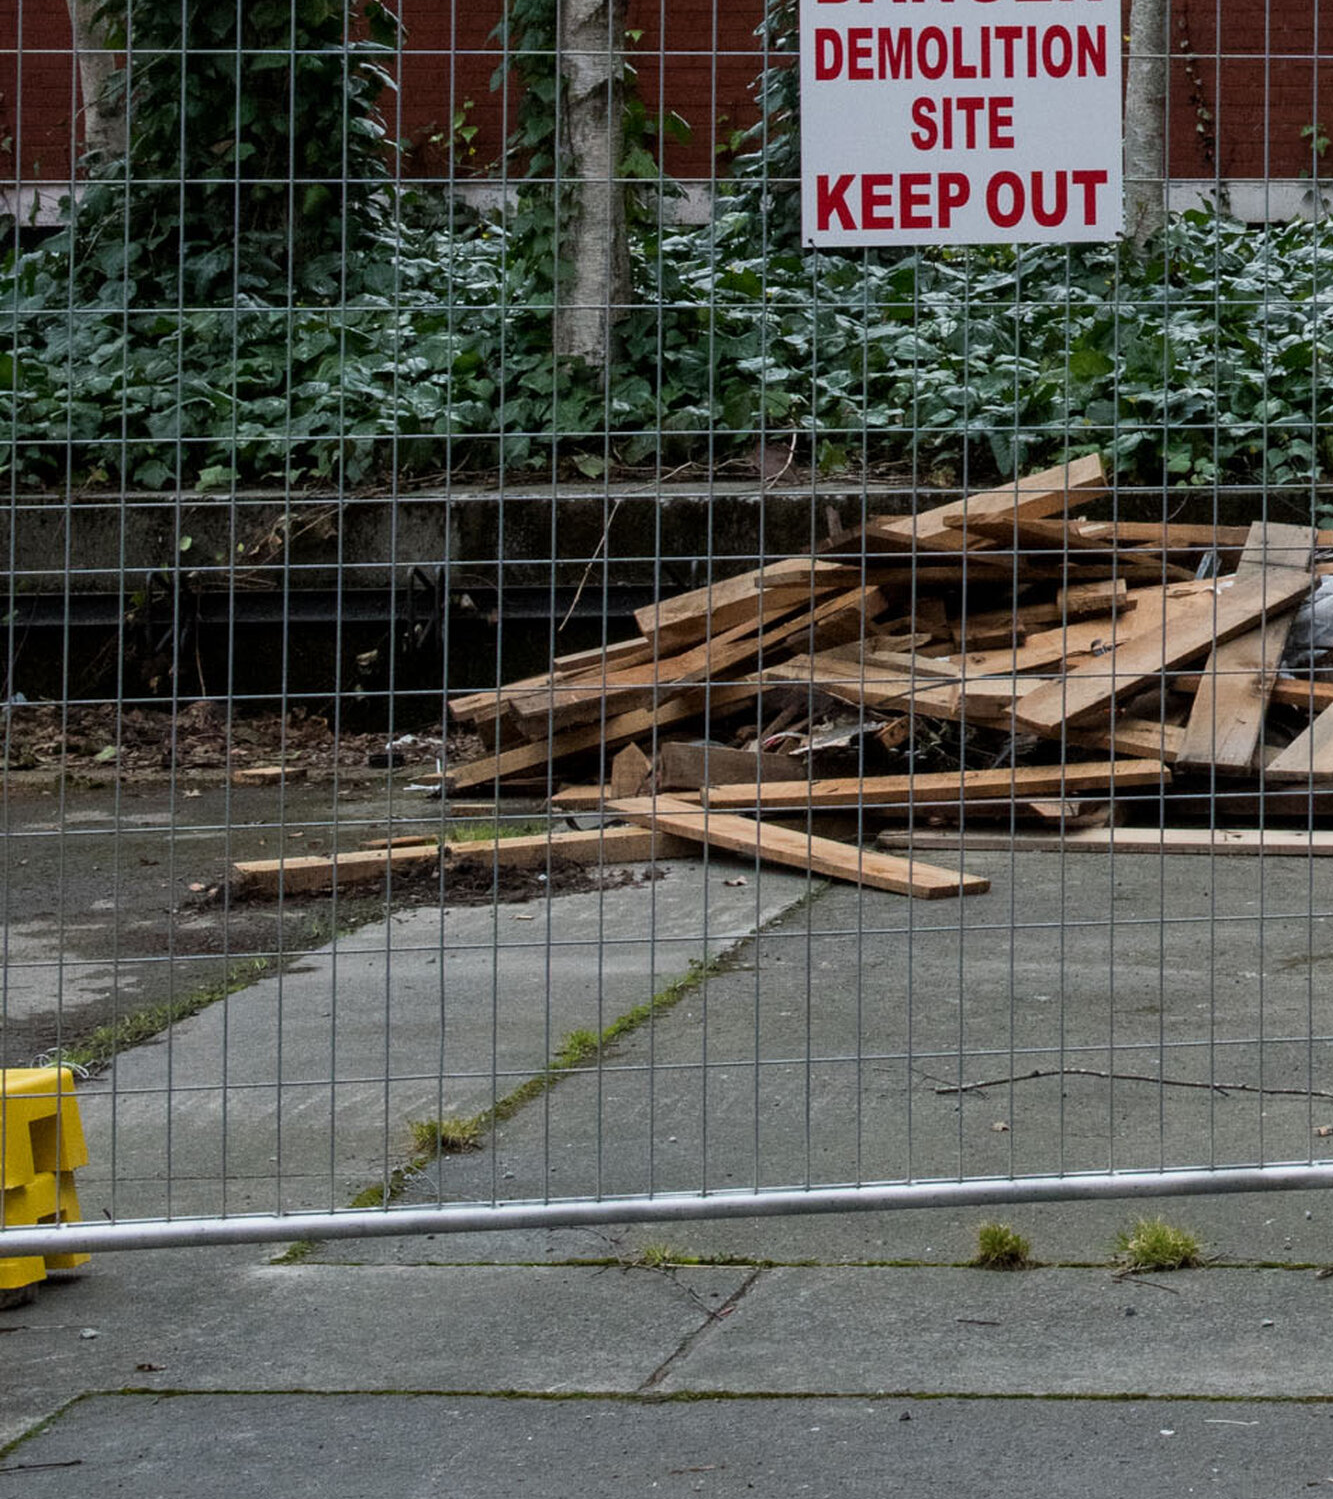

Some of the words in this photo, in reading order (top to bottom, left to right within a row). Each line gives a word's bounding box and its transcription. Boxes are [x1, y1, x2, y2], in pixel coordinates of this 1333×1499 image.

[814, 24, 1107, 81] DEMOLITION
[911, 96, 1015, 151] SITE
[816, 172, 971, 231] KEEP
[985, 169, 1109, 229] OUT
